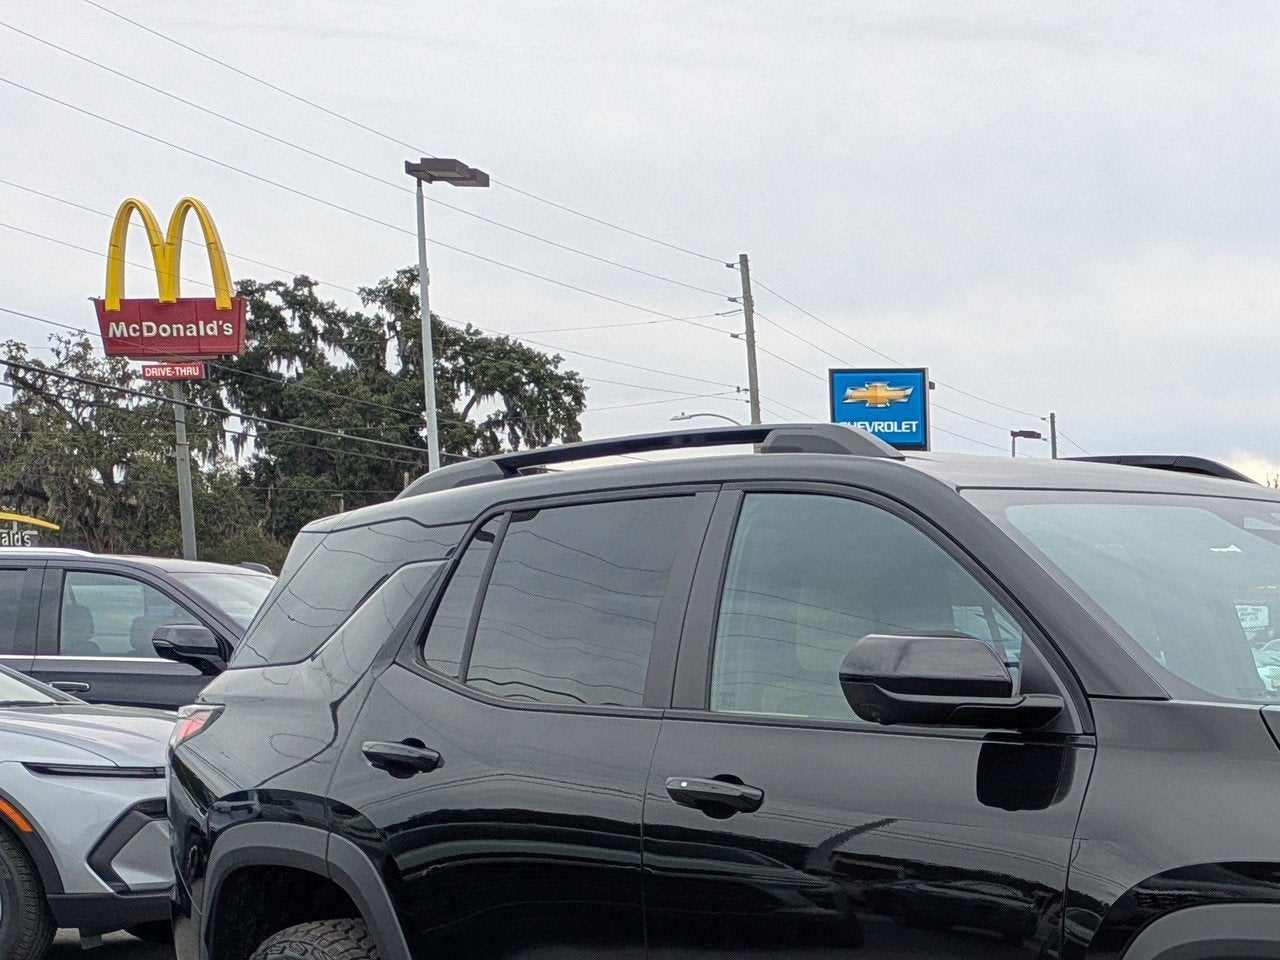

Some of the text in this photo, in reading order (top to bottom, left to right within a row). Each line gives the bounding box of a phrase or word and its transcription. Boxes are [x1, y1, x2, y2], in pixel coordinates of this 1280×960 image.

[108, 320, 233, 338] McDonald's
[145, 366, 200, 377] DRIVE-THRU
[840, 421, 918, 432] EVROLET
